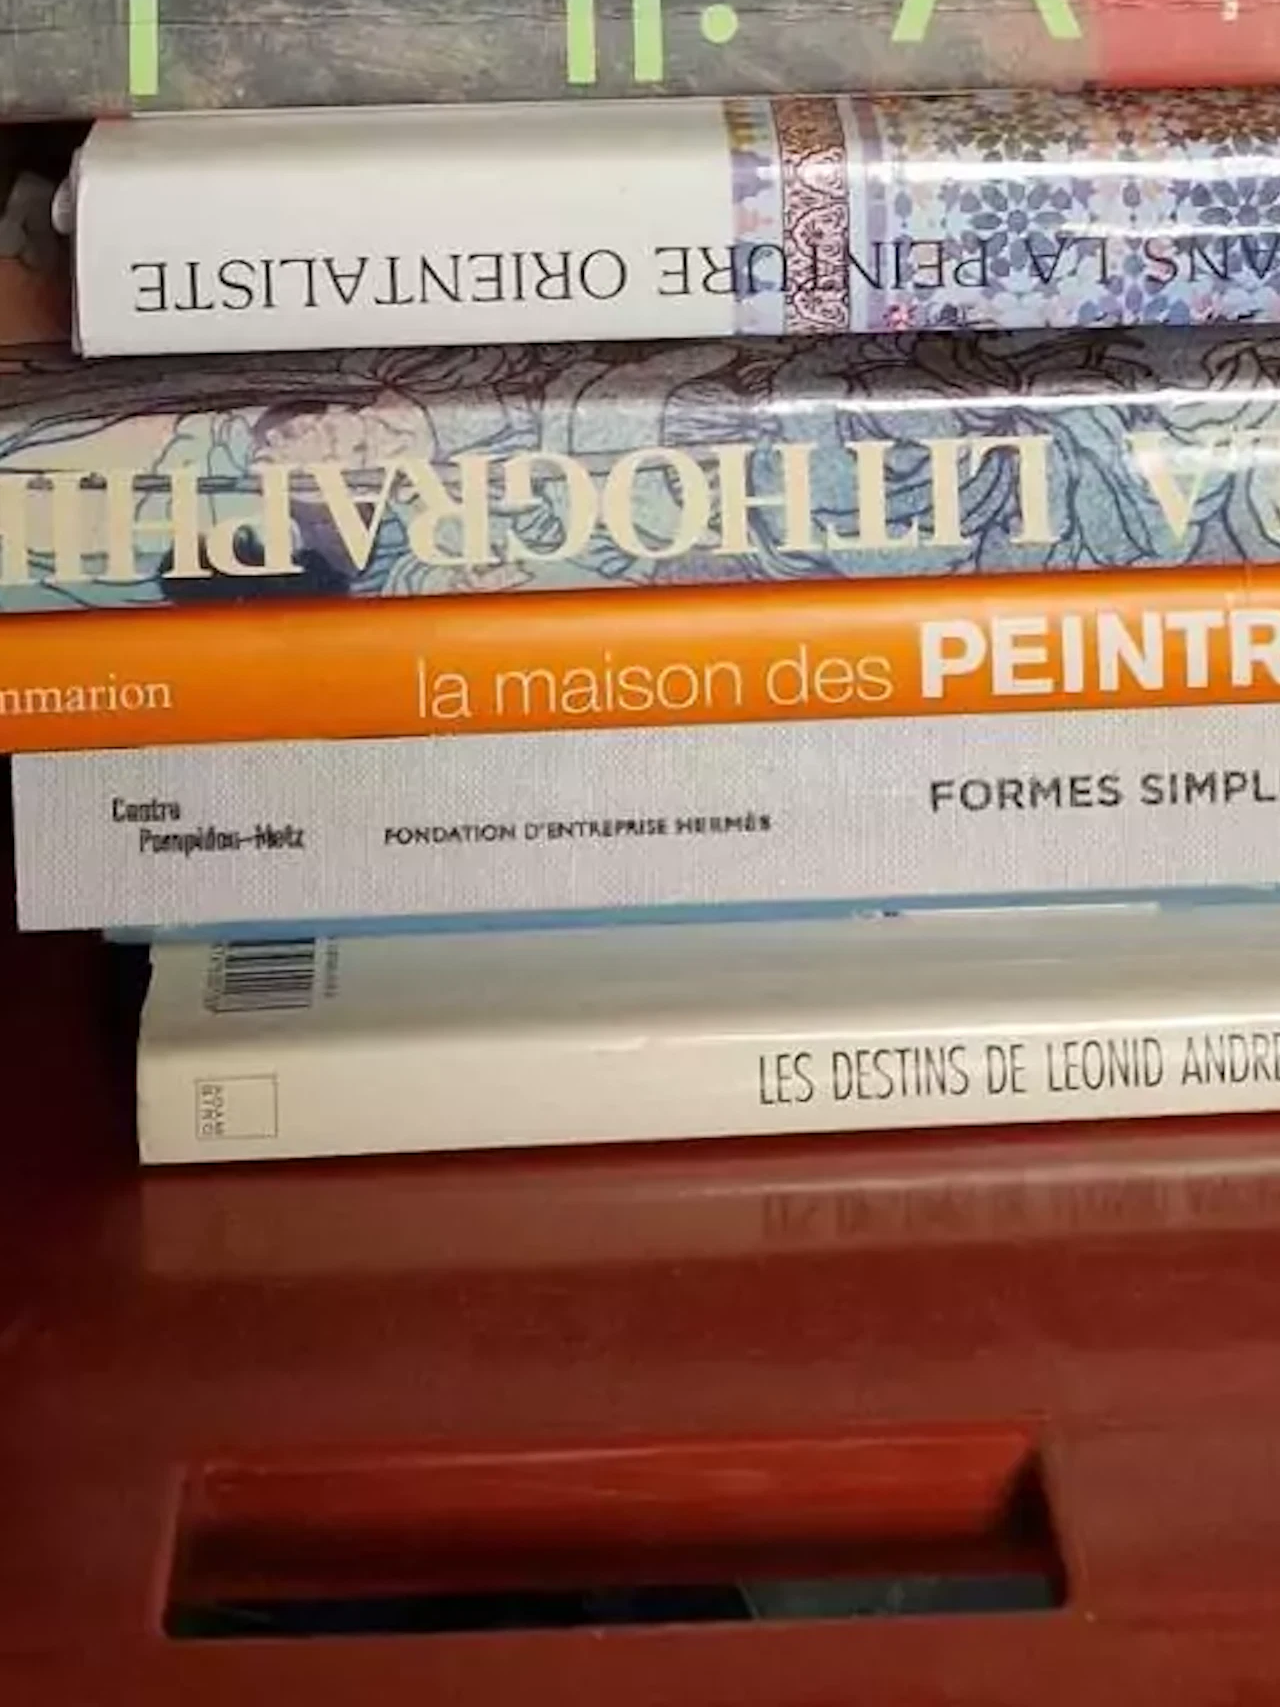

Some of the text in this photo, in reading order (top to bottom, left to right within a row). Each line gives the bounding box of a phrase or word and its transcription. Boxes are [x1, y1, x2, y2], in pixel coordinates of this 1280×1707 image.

[131, 248, 630, 314] ORIENTALISTE
[654, 233, 991, 298] PEINTURE
[1029, 233, 1111, 287] LA
[417, 656, 473, 722] la
[494, 651, 744, 718] maison
[766, 642, 895, 707] des
[111, 797, 182, 824] Centre
[929, 774, 1124, 814] FORMES
[383, 823, 517, 847] FONDATION
[524, 817, 668, 841] D'ENTREPRISE
[758, 1052, 814, 1107] LES
[832, 1043, 971, 1103] DESTINS
[986, 1041, 1028, 1097] DE
[1046, 1038, 1165, 1095] LEONID
